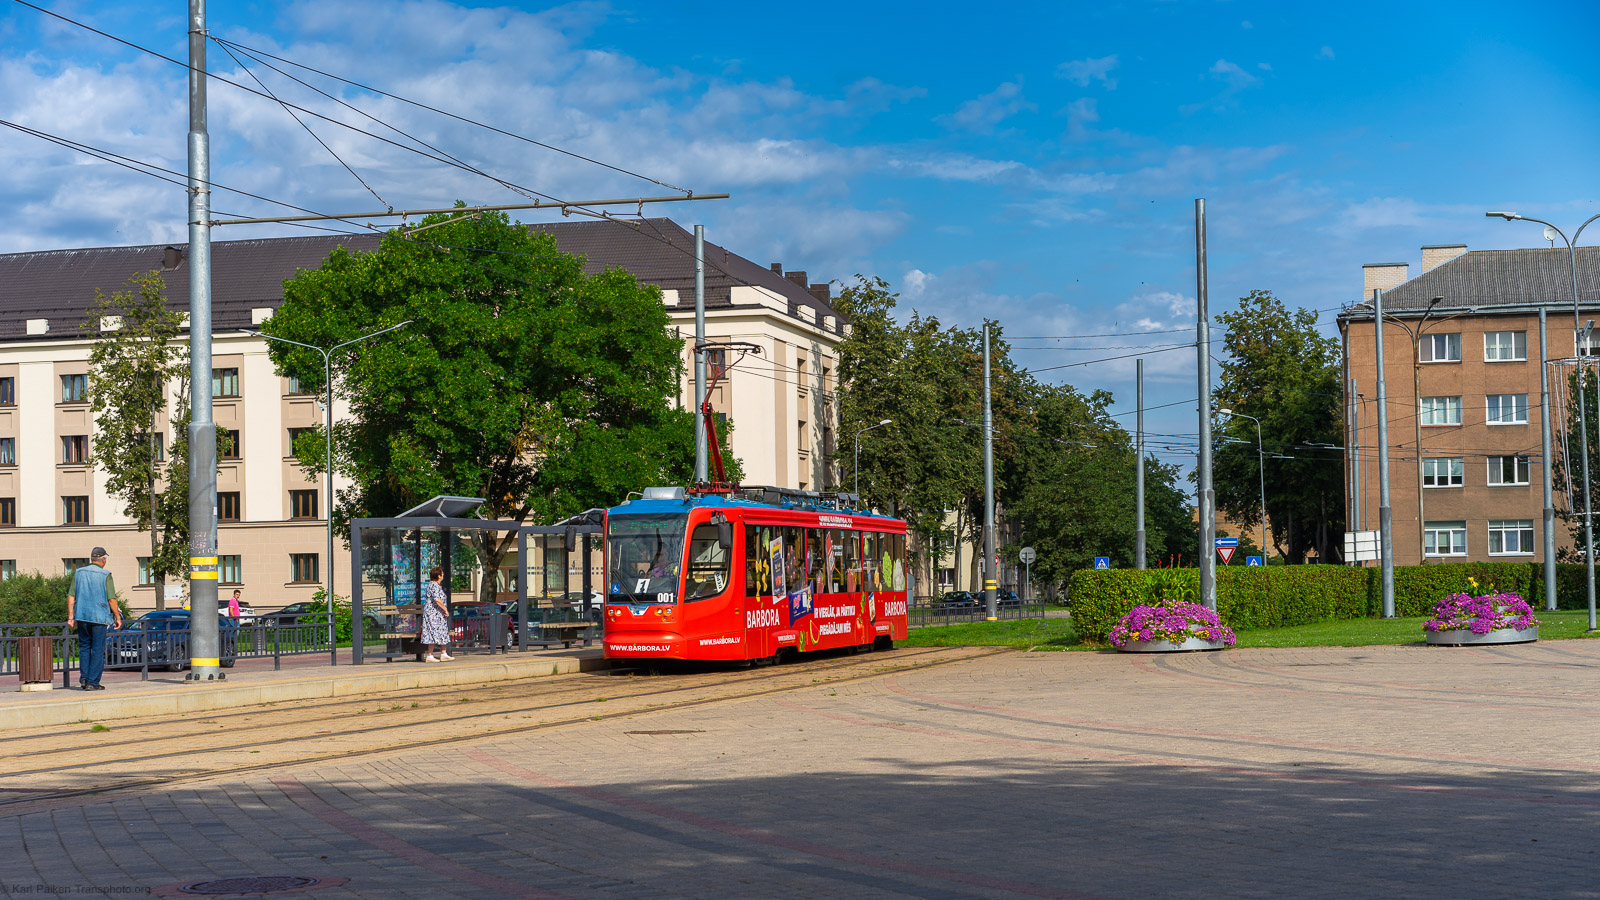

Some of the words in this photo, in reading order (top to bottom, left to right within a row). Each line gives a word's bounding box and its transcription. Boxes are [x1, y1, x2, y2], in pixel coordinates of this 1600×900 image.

[657, 592, 674, 603] 001
[885, 600, 907, 617] BARBORA
[746, 608, 781, 629] BARBORA
[699, 636, 741, 646] WWW.BARBORA.LV
[609, 644, 671, 652] WWW.BARBORA.LV
